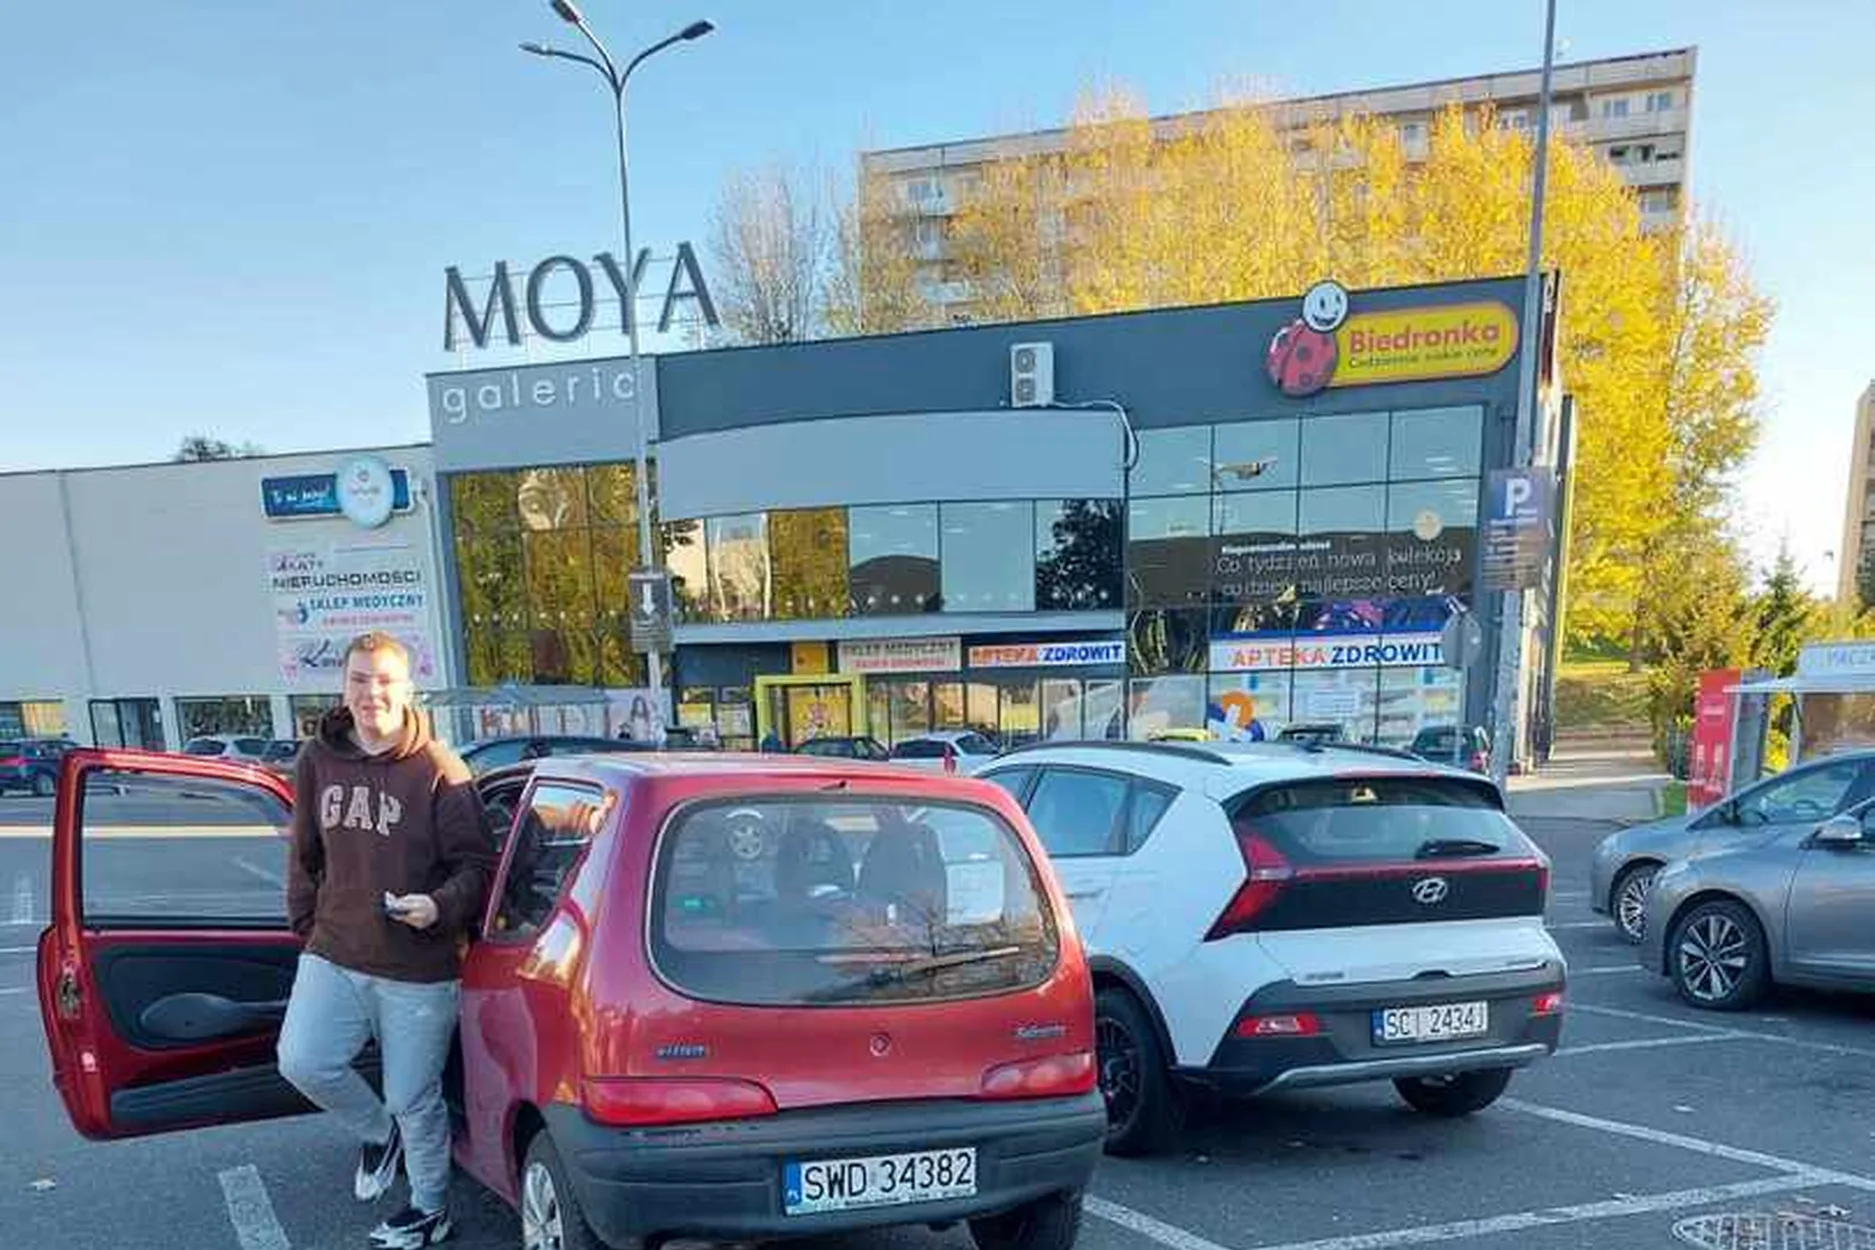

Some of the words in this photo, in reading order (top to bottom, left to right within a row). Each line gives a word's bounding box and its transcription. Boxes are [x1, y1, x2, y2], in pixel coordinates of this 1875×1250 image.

[444, 241, 720, 351] MOYA
[1350, 320, 1500, 353] Biedronka
[1044, 644, 1122, 661] ZDROWIT
[1232, 647, 1326, 667] APTEKA
[1331, 642, 1442, 664] ZDROWIT
[321, 784, 402, 836] GAP
[1387, 1011, 1410, 1037] SC
[805, 1163, 867, 1200] SWD
[880, 1152, 972, 1193] 34382
